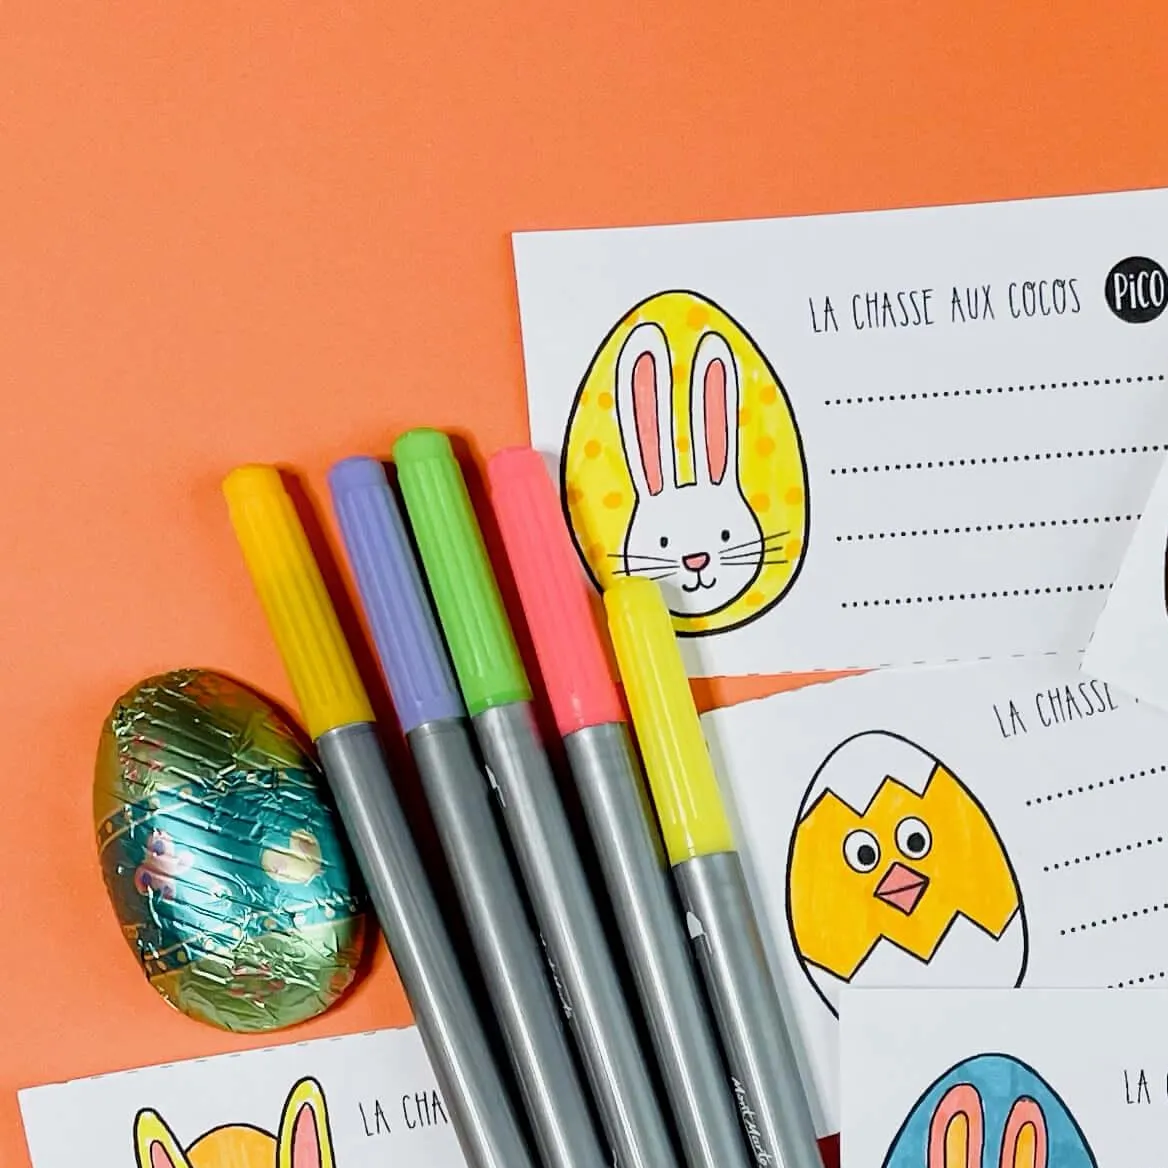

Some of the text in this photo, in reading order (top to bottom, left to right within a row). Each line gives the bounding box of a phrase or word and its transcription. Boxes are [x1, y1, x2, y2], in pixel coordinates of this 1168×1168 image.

[809, 279, 1080, 332] LA CHASSE AUX COCOS
[993, 700, 1027, 738] LA
[1124, 1069, 1150, 1104] LA
[359, 1090, 448, 1136] LA CHA
